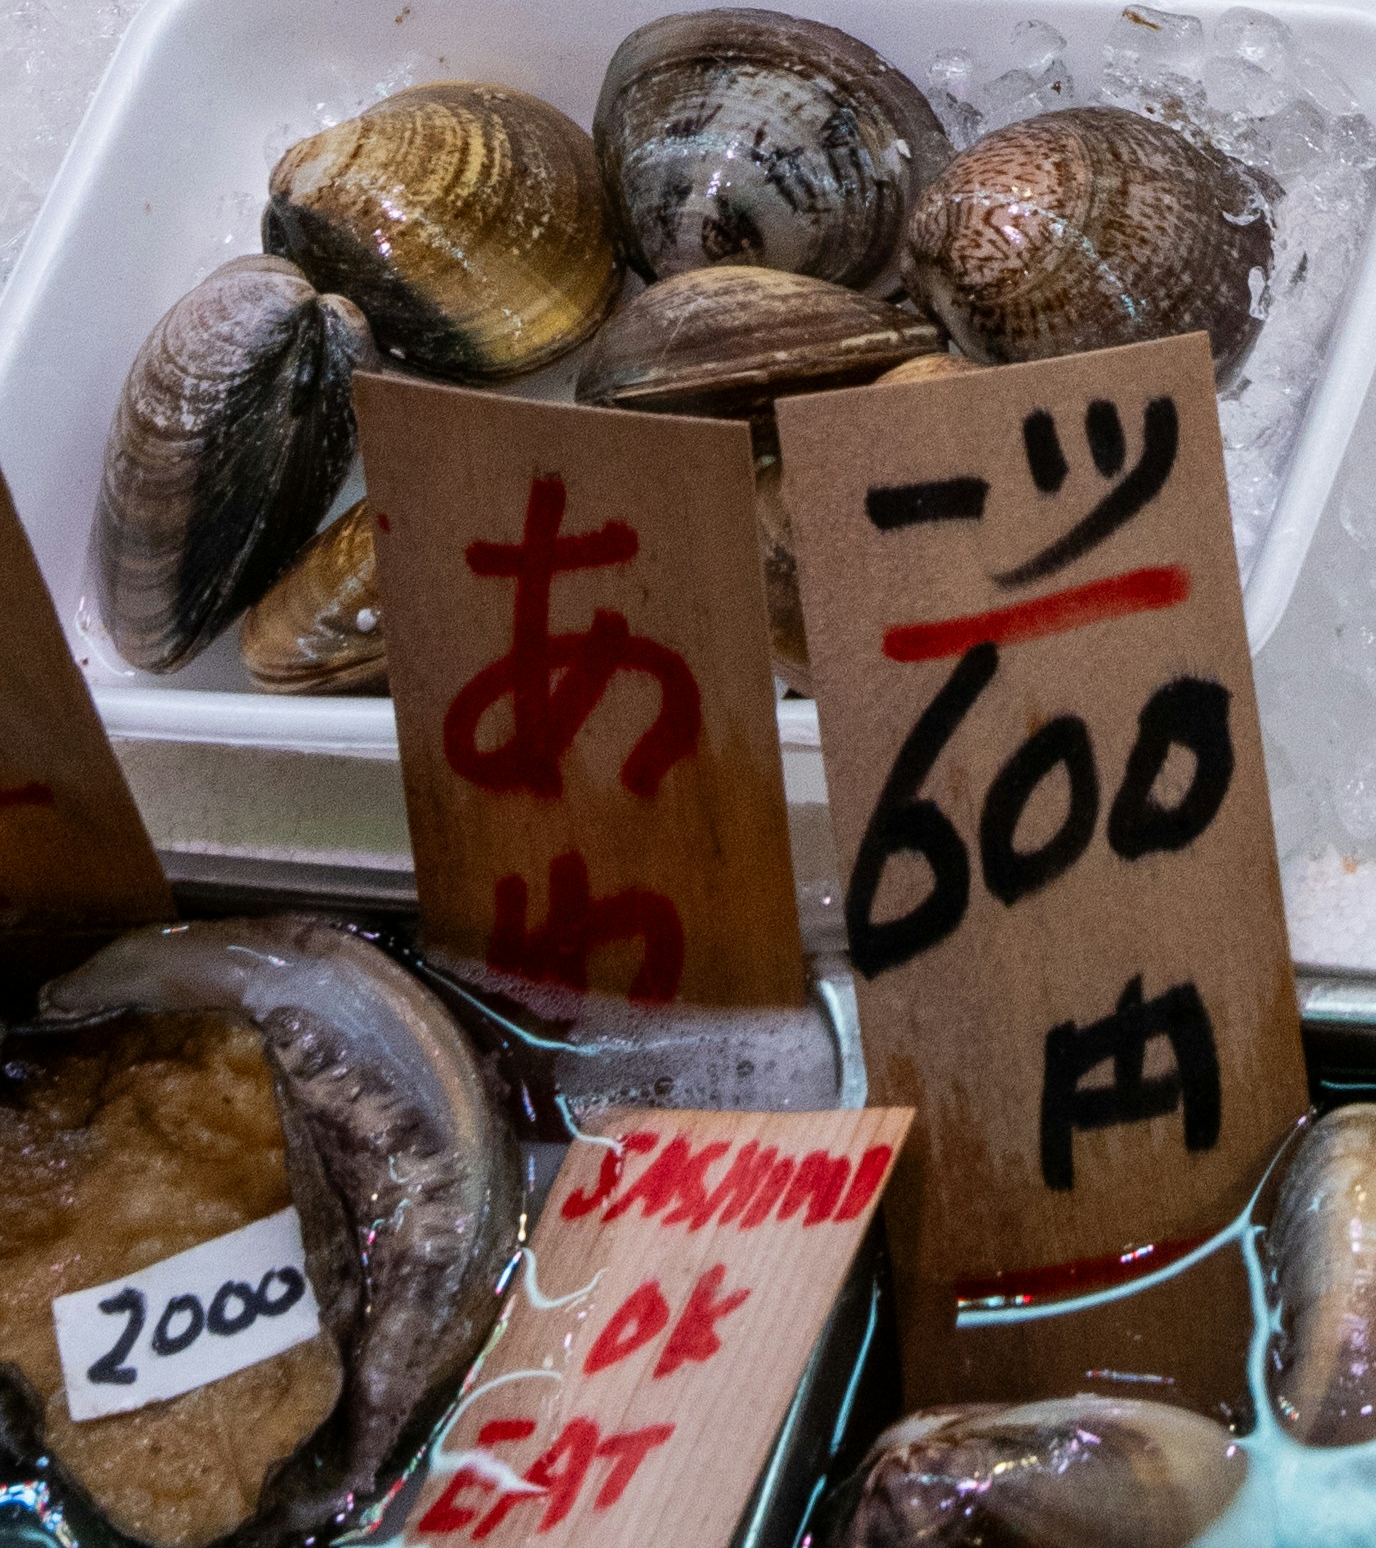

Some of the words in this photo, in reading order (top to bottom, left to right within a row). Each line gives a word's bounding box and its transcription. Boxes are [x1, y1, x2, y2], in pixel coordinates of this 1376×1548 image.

[864, 396, 1178, 590] 一ツ
[846, 642, 1234, 981] 600
[1041, 974, 1221, 1190] 円
[561, 1132, 895, 1232] SASHIMI
[87, 1265, 306, 1384] 2000
[585, 1263, 751, 1377] OK
[417, 1416, 676, 1542] EAT
